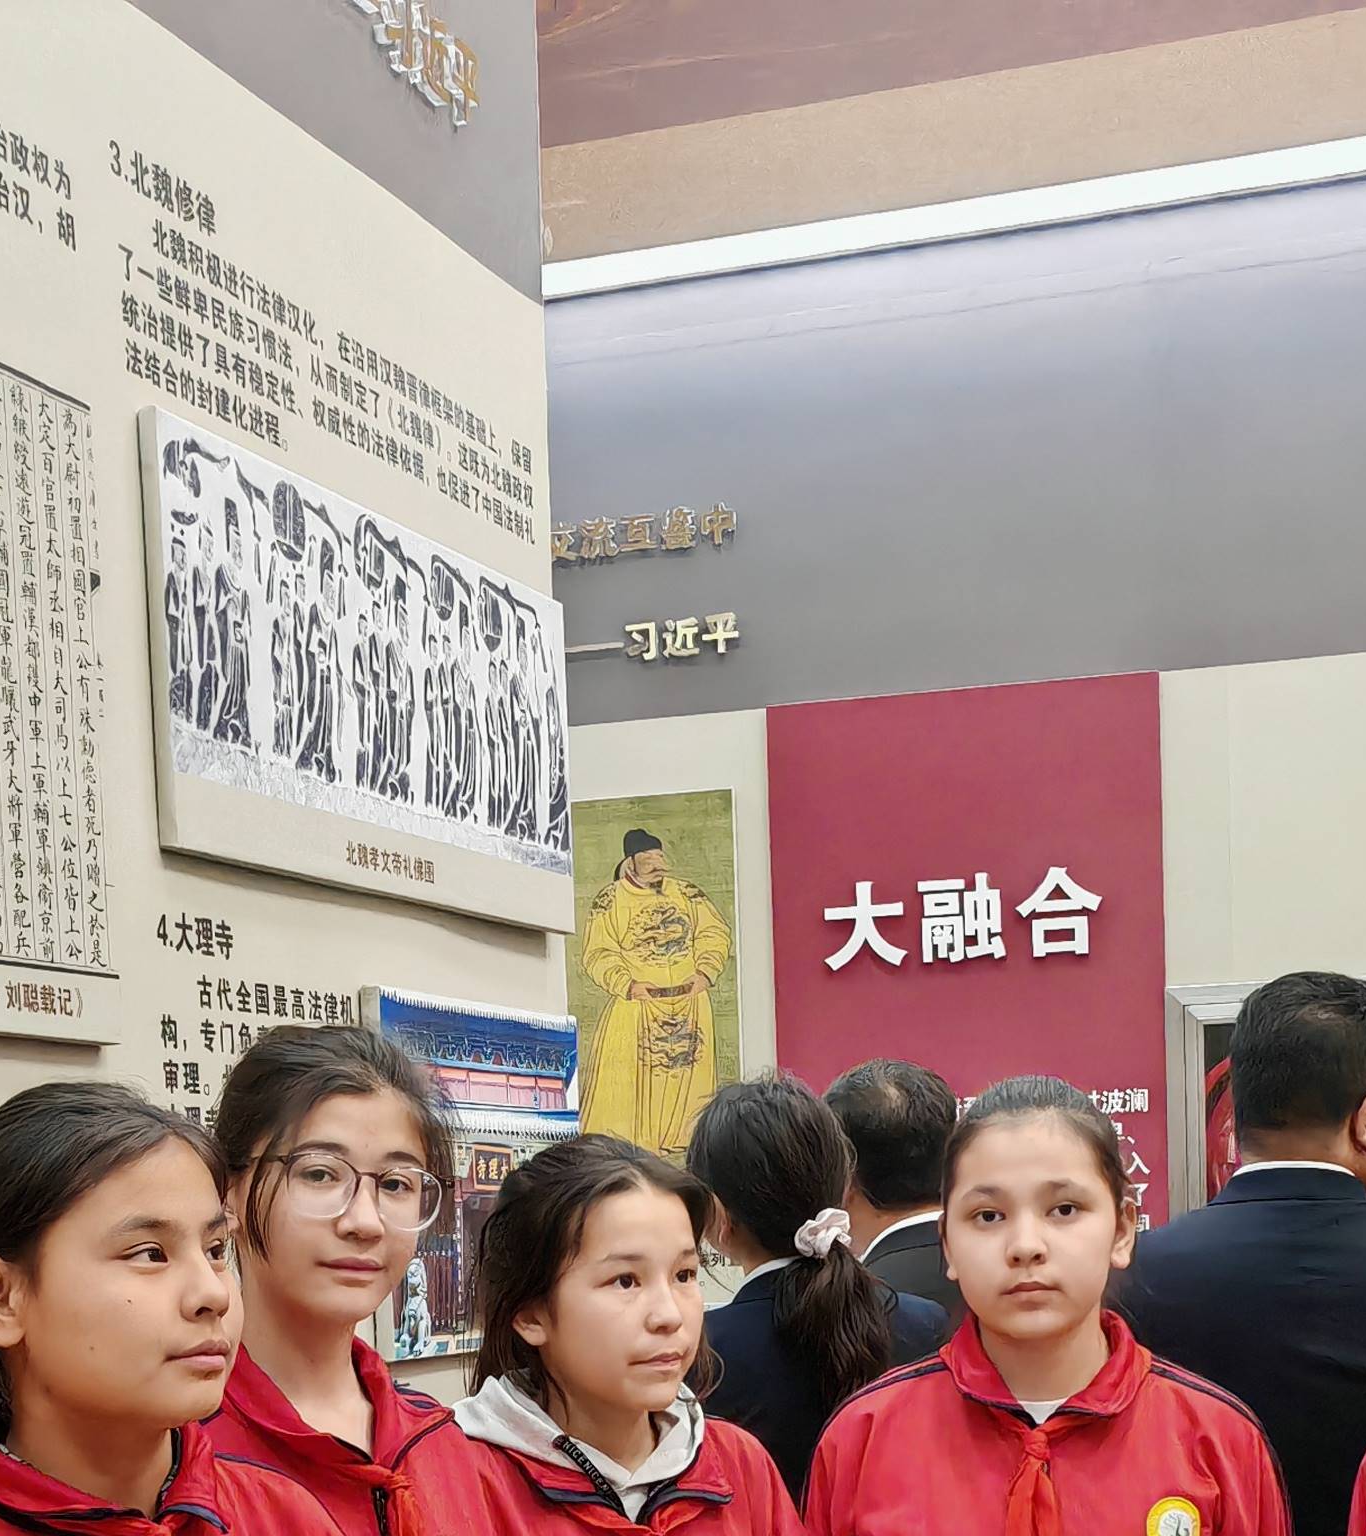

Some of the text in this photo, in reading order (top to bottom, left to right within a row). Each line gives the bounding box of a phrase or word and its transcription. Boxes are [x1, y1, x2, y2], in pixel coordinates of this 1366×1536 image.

[108, 140, 217, 238] 3.北魏修律
[156, 912, 234, 961] 4.大理寺
[823, 866, 1103, 972] 大融合
[196, 974, 355, 1024] 古代全国最高法律机
